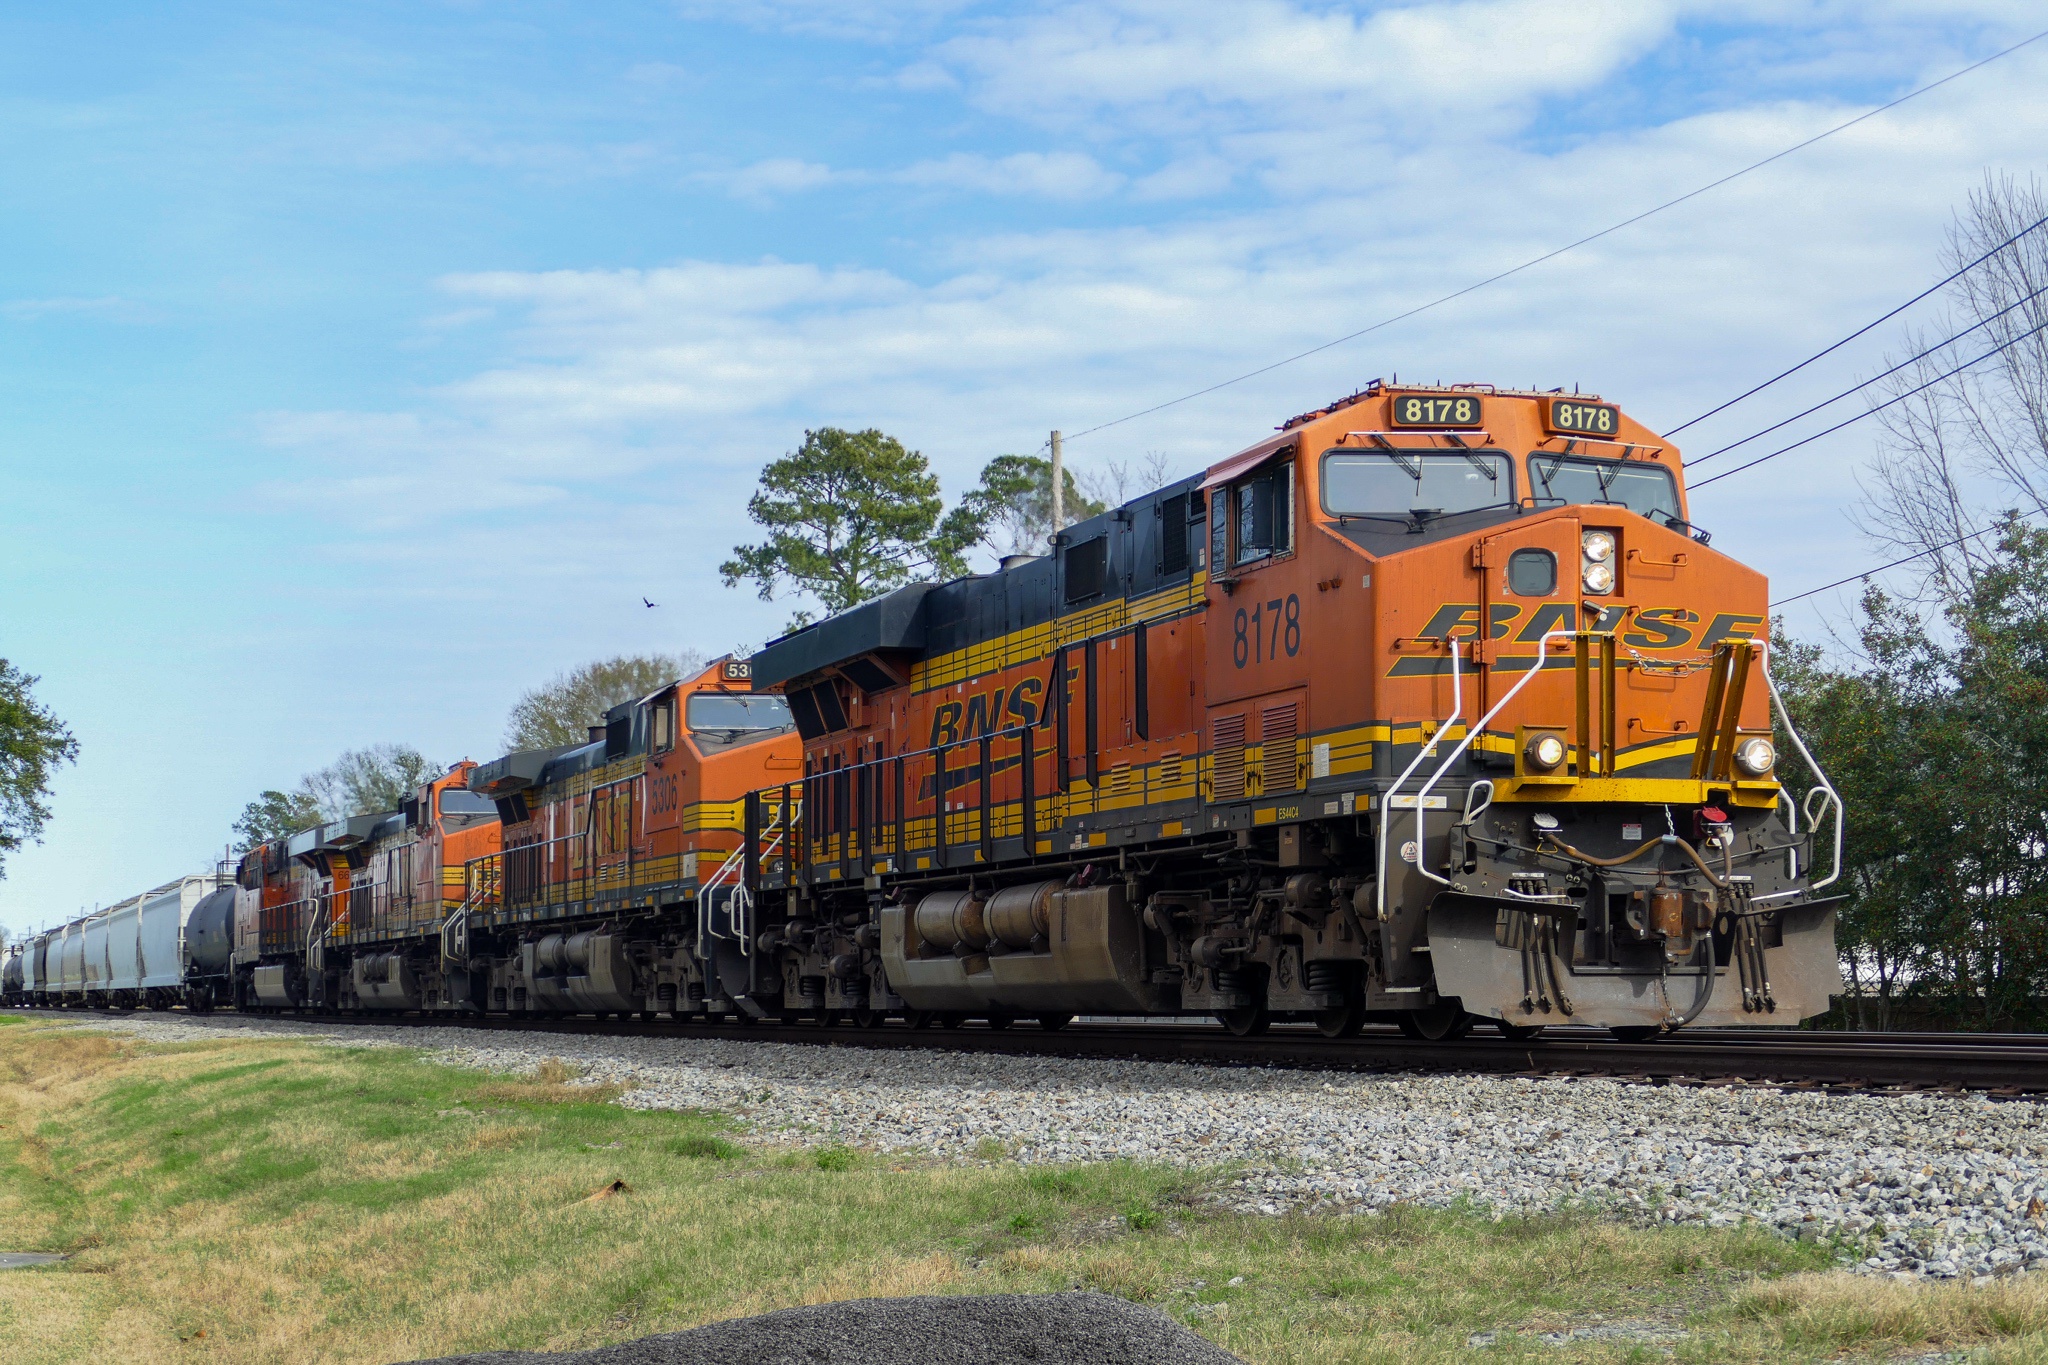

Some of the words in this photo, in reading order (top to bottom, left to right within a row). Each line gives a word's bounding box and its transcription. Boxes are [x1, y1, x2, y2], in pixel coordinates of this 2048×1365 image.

[1405, 399, 1471, 422] 8178
[1559, 404, 1611, 431] 8178
[1233, 593, 1301, 670] 8178
[1410, 602, 1766, 652] BNSF
[728, 663, 752, 678] 53
[652, 773, 678, 816] 5306
[1278, 806, 1299, 820] ES44C4
